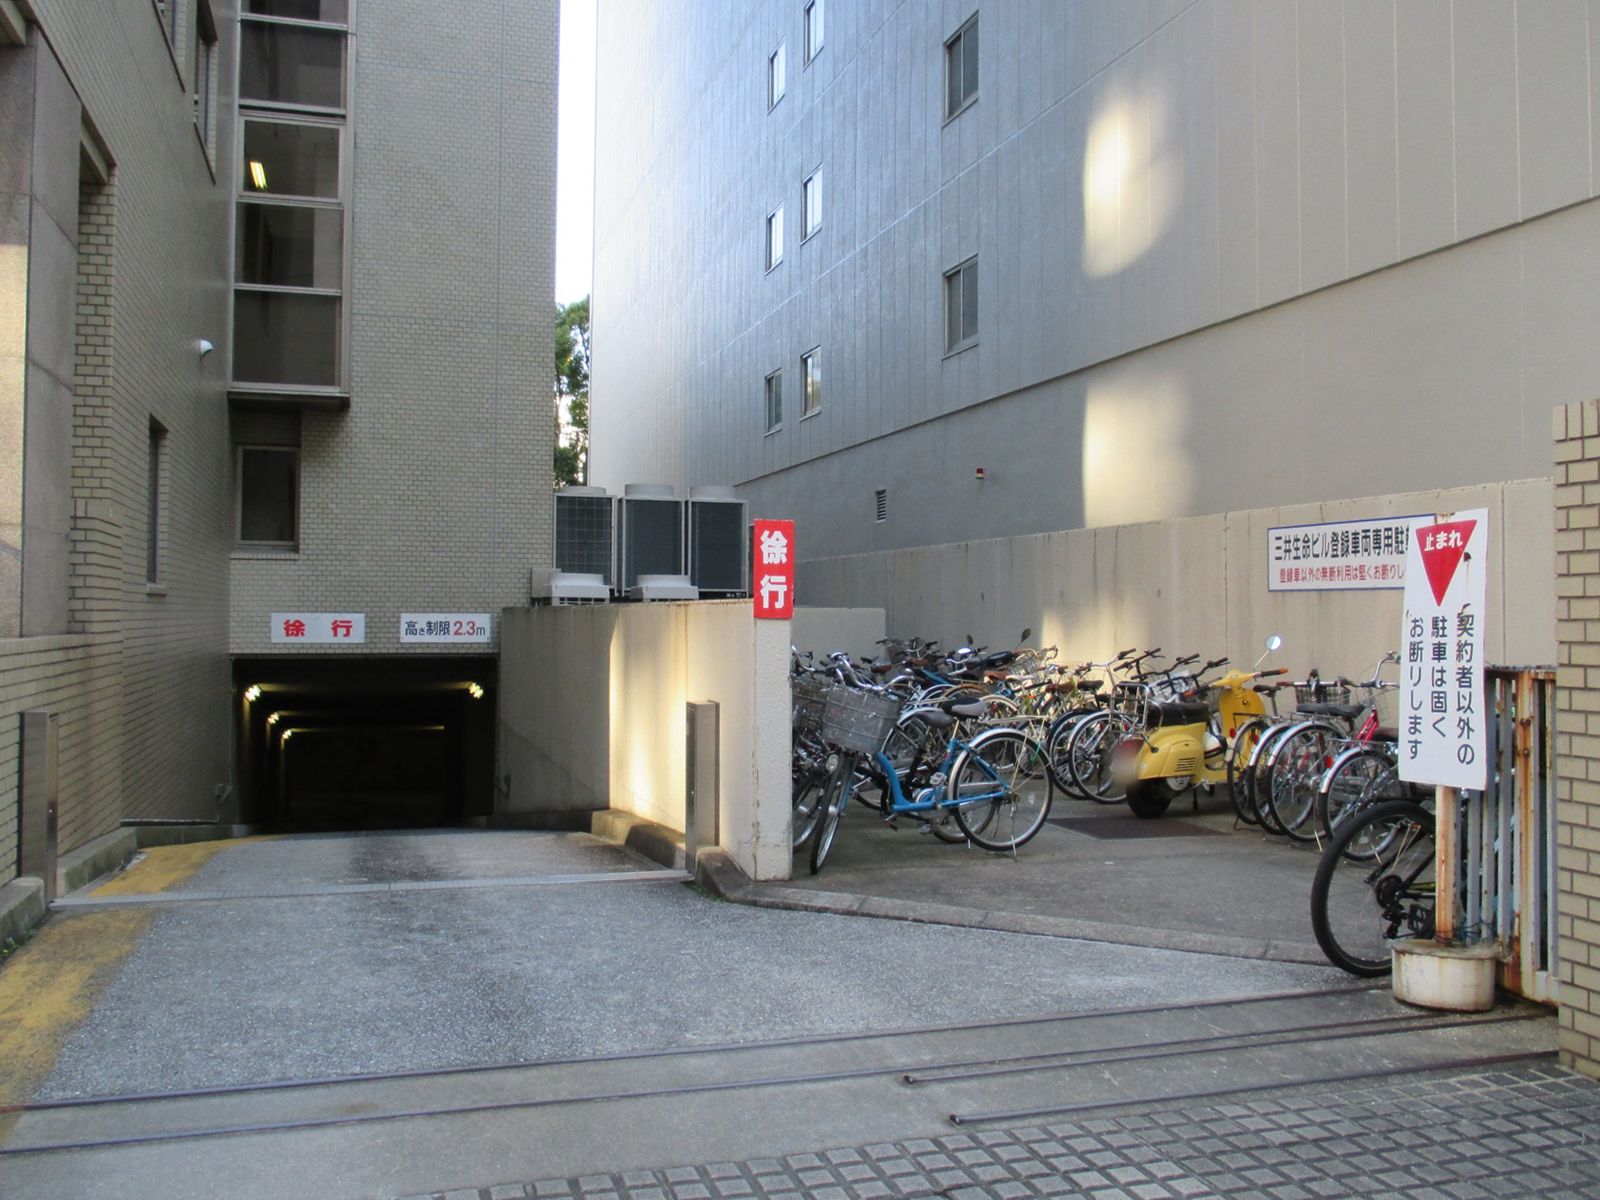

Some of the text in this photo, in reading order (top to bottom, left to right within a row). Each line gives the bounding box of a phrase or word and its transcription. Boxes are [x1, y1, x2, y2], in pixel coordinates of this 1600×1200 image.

[760, 529, 788, 609] 徐行
[1424, 529, 1463, 552] 止まれ
[283, 619, 353, 638] 徐行
[1431, 615, 1448, 738] 駐車は固く
[1408, 617, 1424, 760] お断りします
[1455, 612, 1476, 766] 契約者以外の
